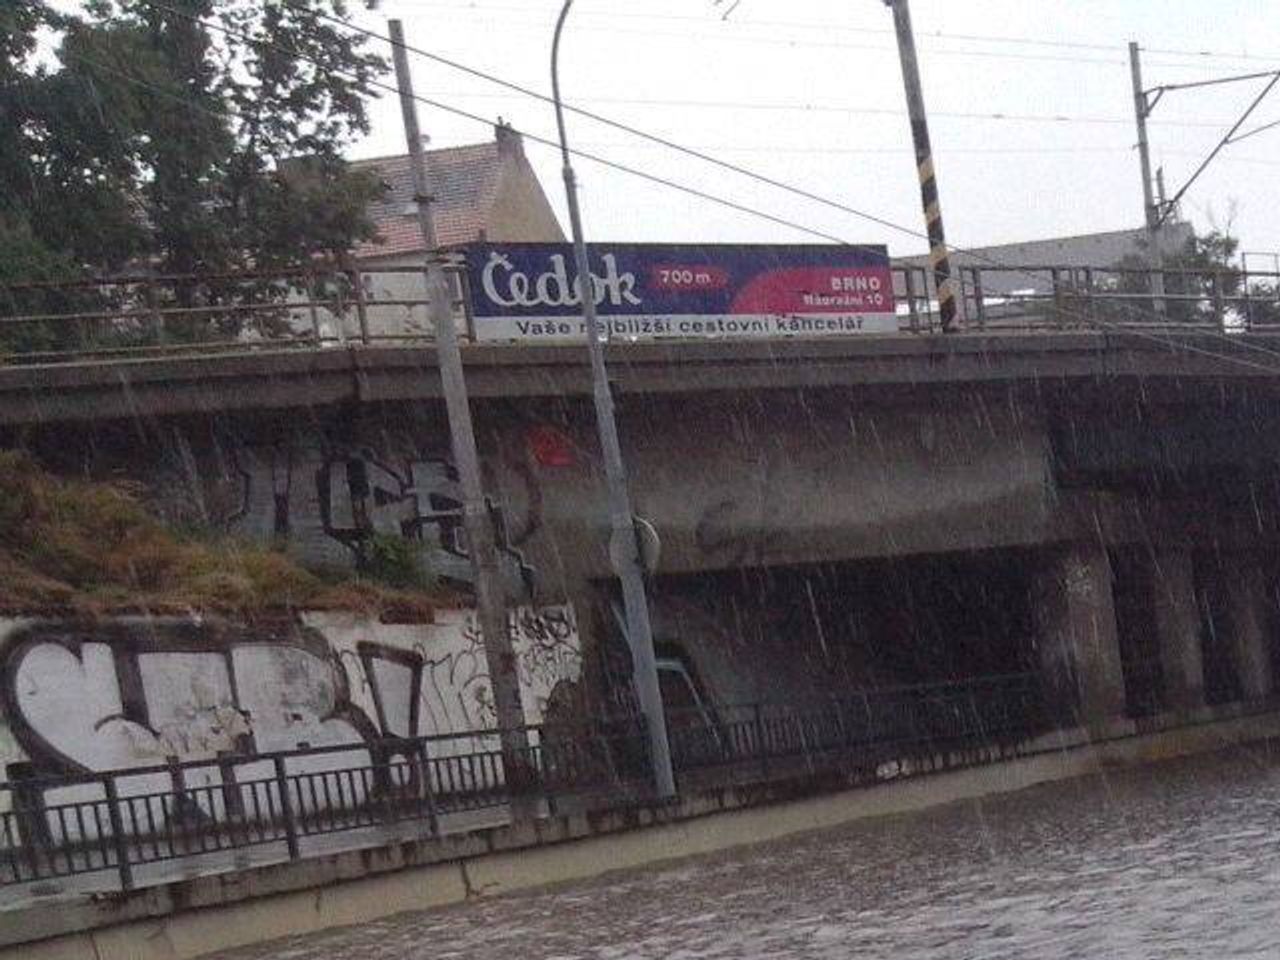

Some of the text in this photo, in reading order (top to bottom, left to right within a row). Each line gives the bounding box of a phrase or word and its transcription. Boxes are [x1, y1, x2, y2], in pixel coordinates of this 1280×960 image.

[481, 251, 642, 306] Čedok
[660, 270, 711, 284] 700 m
[831, 276, 881, 291] BRNO
[516, 320, 571, 335] Vaše
